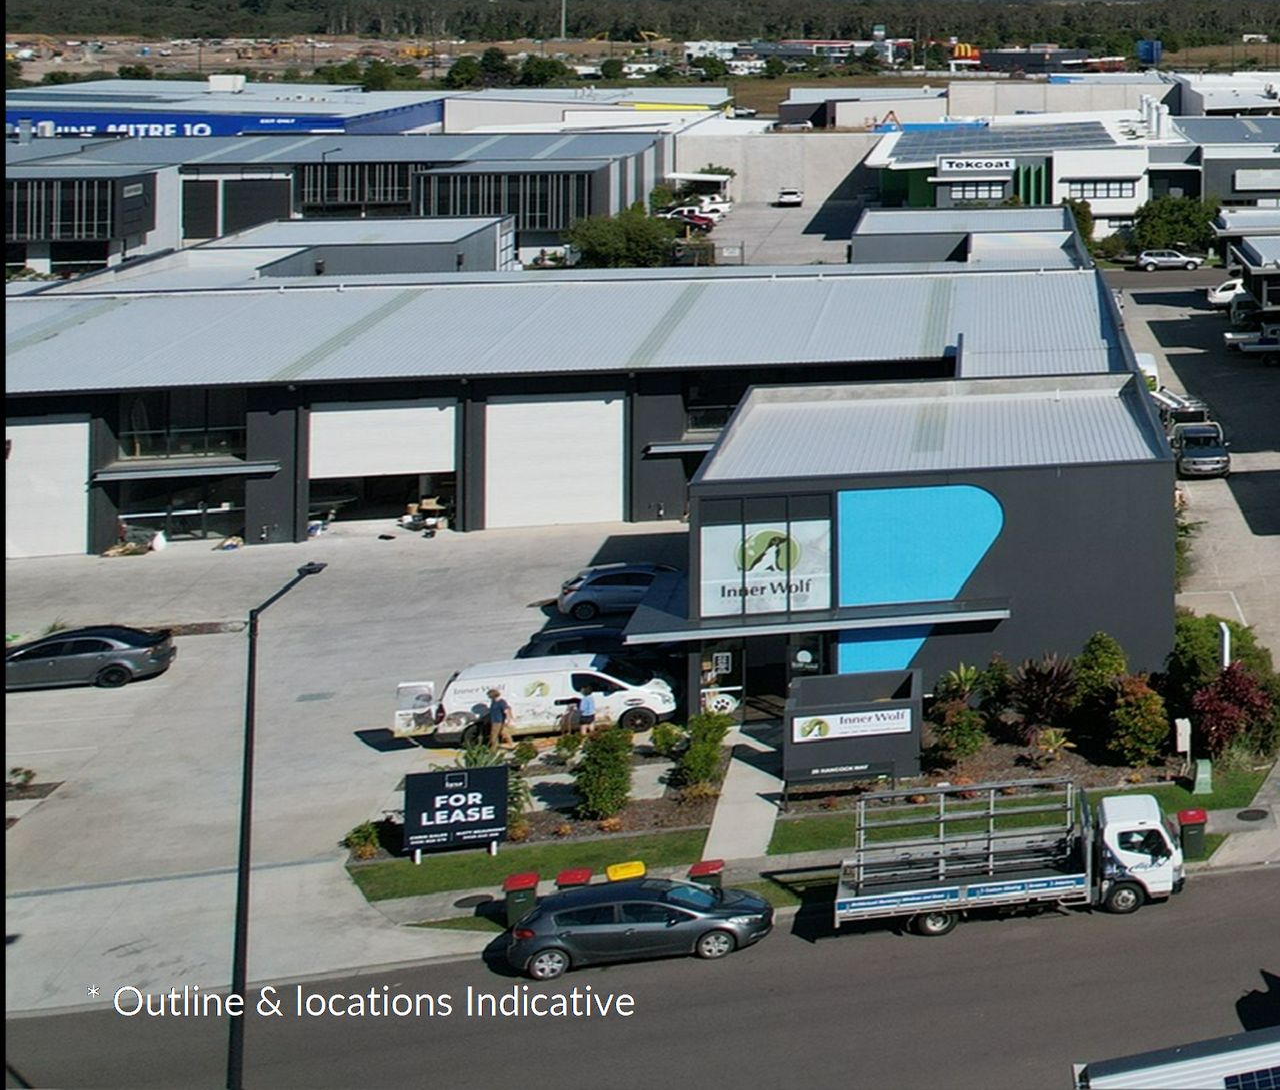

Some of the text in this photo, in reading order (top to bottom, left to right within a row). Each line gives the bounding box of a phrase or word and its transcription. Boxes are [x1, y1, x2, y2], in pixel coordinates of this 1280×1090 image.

[183, 123, 212, 137] 10
[946, 160, 1010, 169] Tekcoat
[720, 578, 813, 598] Inner Wolf
[839, 711, 905, 725] Inner Wolf
[435, 792, 482, 808] FOR
[421, 806, 495, 826] LEASE
